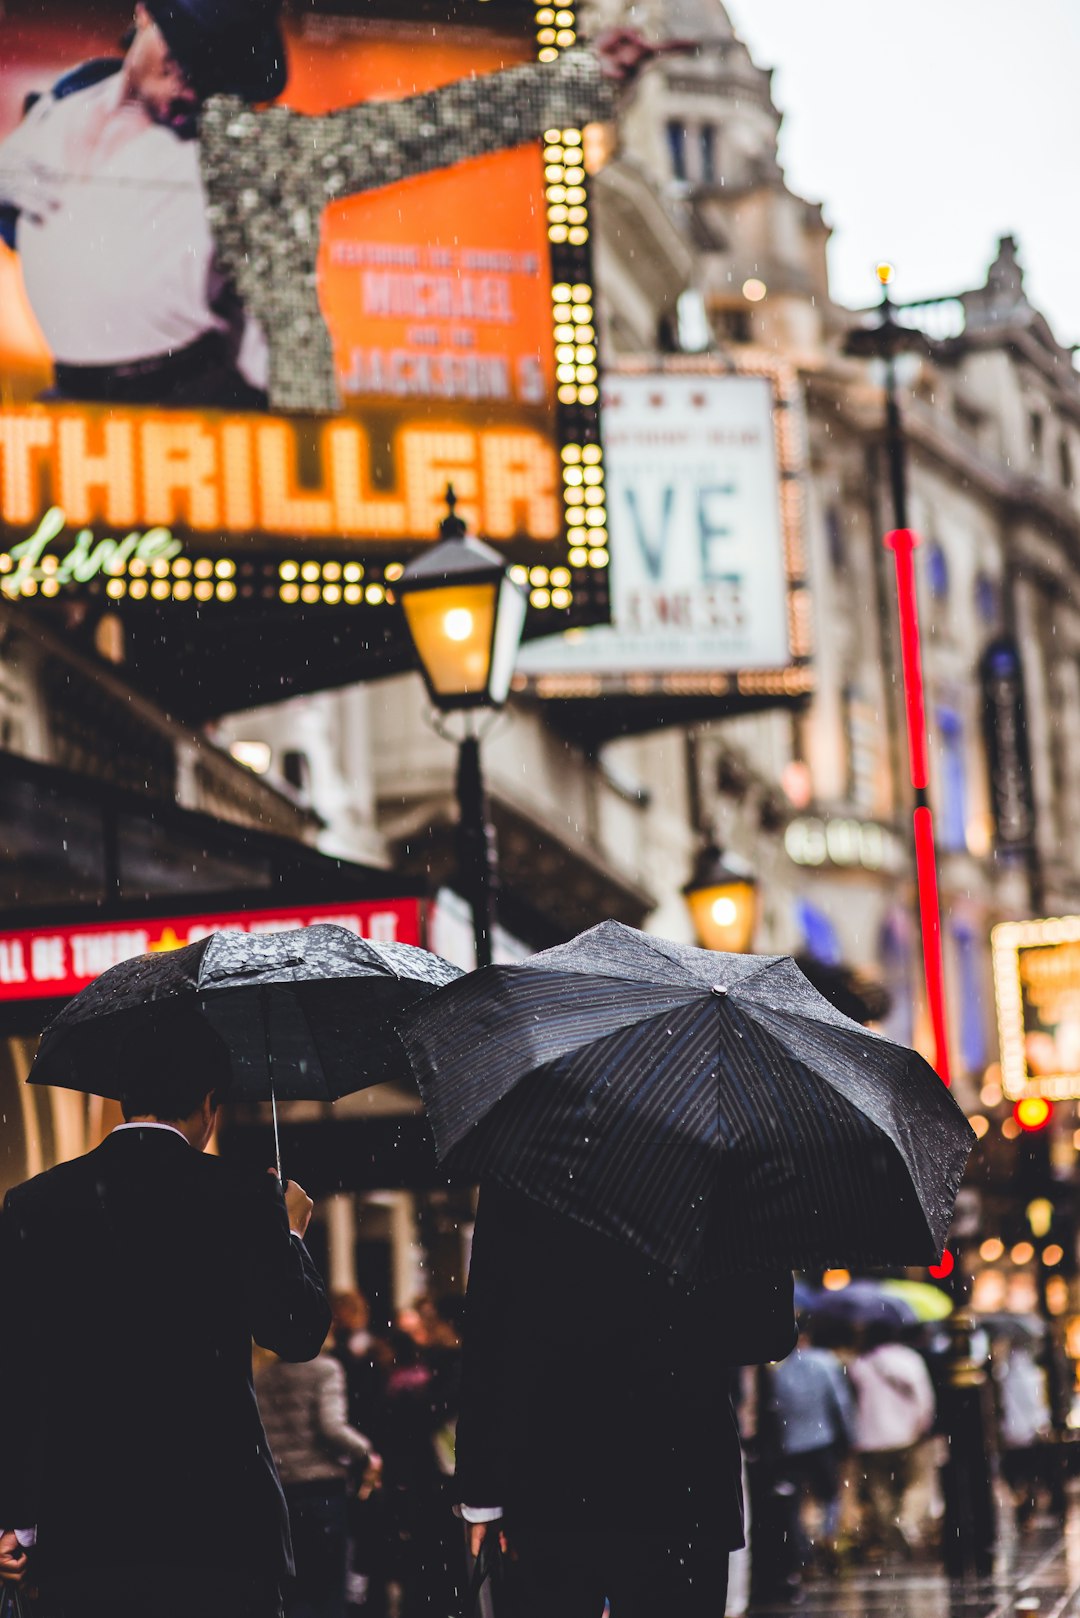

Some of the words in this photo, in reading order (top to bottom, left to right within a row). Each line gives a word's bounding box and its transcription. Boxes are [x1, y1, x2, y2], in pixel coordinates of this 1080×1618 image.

[362, 270, 514, 323] MICHAEL
[345, 348, 508, 399] JACKSON
[0, 416, 558, 539] THRILLER
[1, 506, 183, 599] Live
[32, 934, 67, 981] BE
